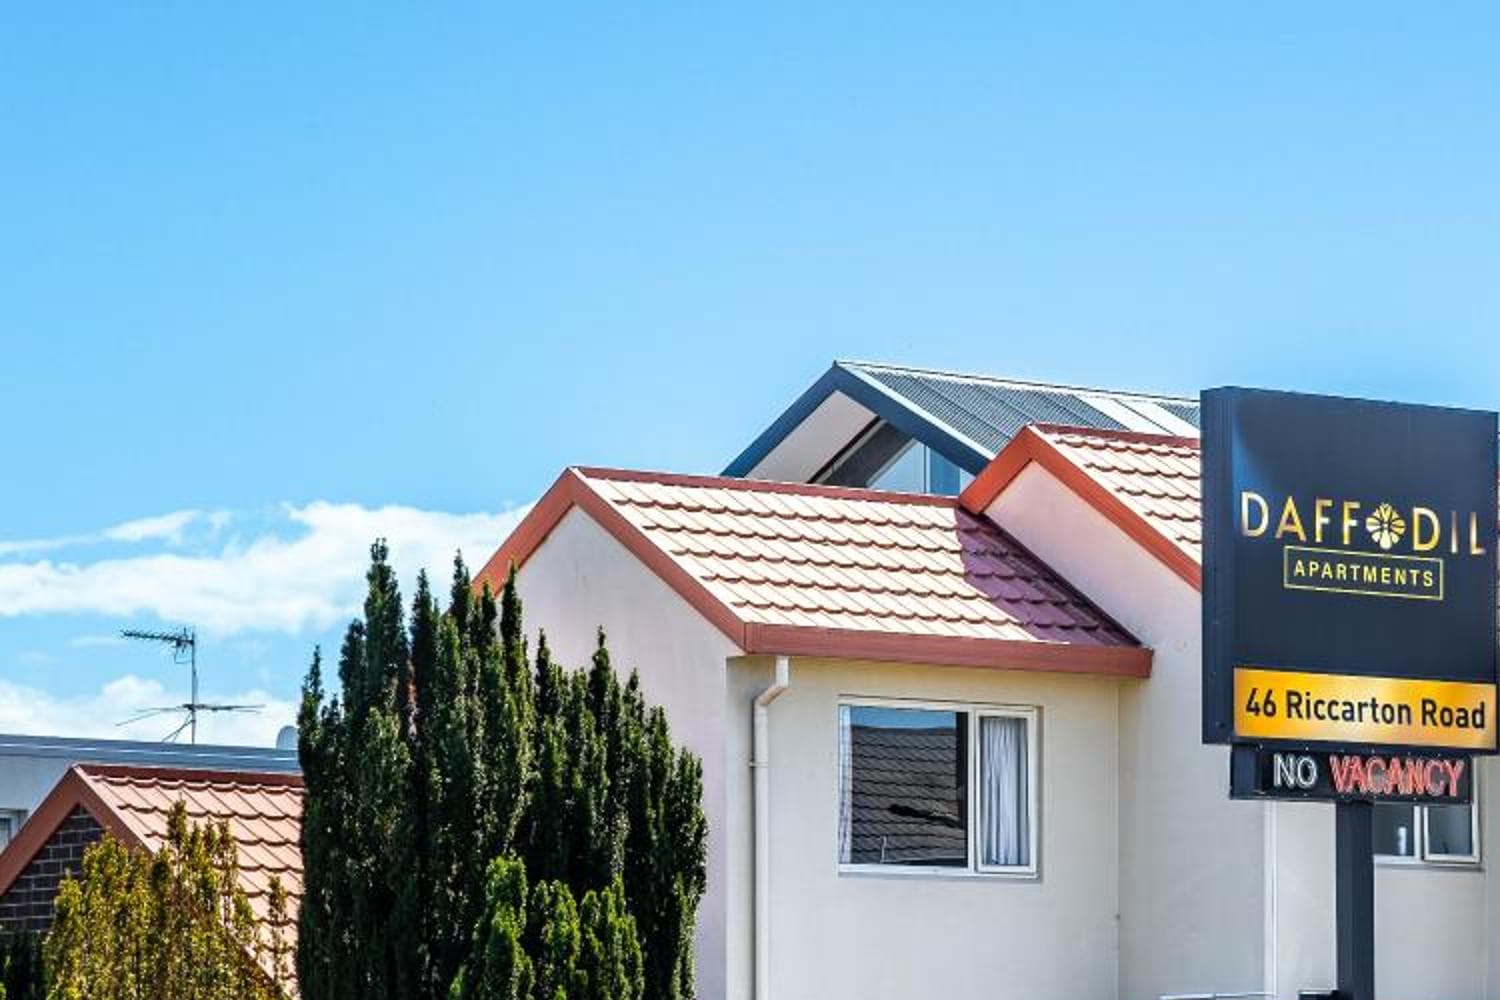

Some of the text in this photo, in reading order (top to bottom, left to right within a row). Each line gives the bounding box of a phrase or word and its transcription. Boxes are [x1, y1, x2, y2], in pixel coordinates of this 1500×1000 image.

[1294, 560, 1434, 587] APARTMENTS
[1246, 687, 1486, 729] 46 Riccarton Road
[1273, 753, 1465, 797] NO VACANCY
